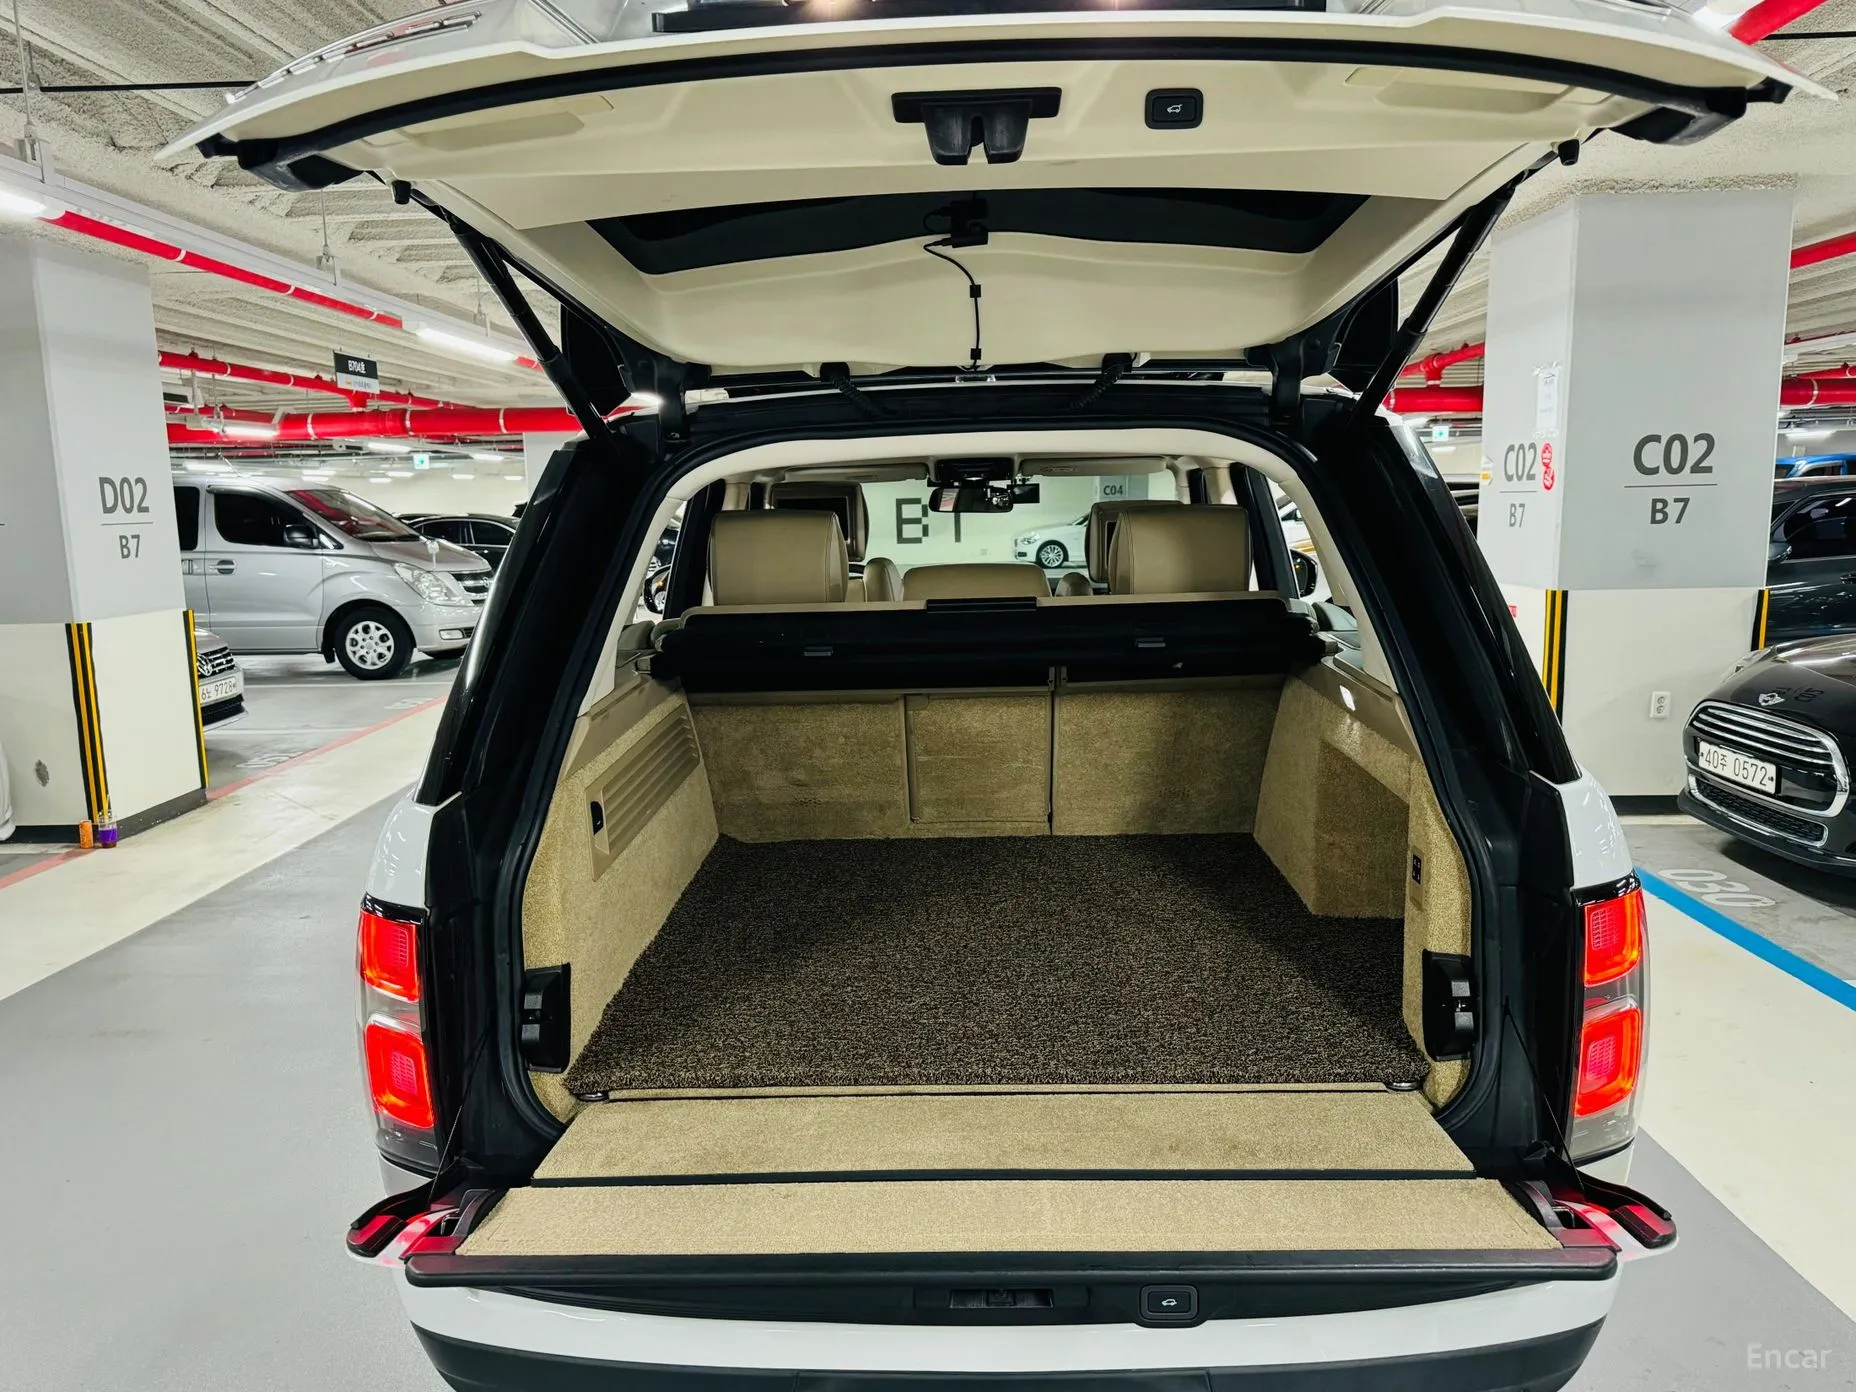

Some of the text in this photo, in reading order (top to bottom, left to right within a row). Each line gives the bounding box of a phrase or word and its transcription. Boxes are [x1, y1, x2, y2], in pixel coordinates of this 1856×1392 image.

[1503, 442, 1537, 482] C02
[1633, 432, 1715, 476] C02
[98, 476, 150, 514] D02
[1103, 483, 1124, 497] C04
[1508, 502, 1526, 528] B7
[1650, 497, 1690, 525] B7
[119, 534, 141, 559] B7
[214, 680, 234, 697] 9728
[1704, 748, 1768, 787] 40주 0572
[1657, 868, 1777, 908] 030
